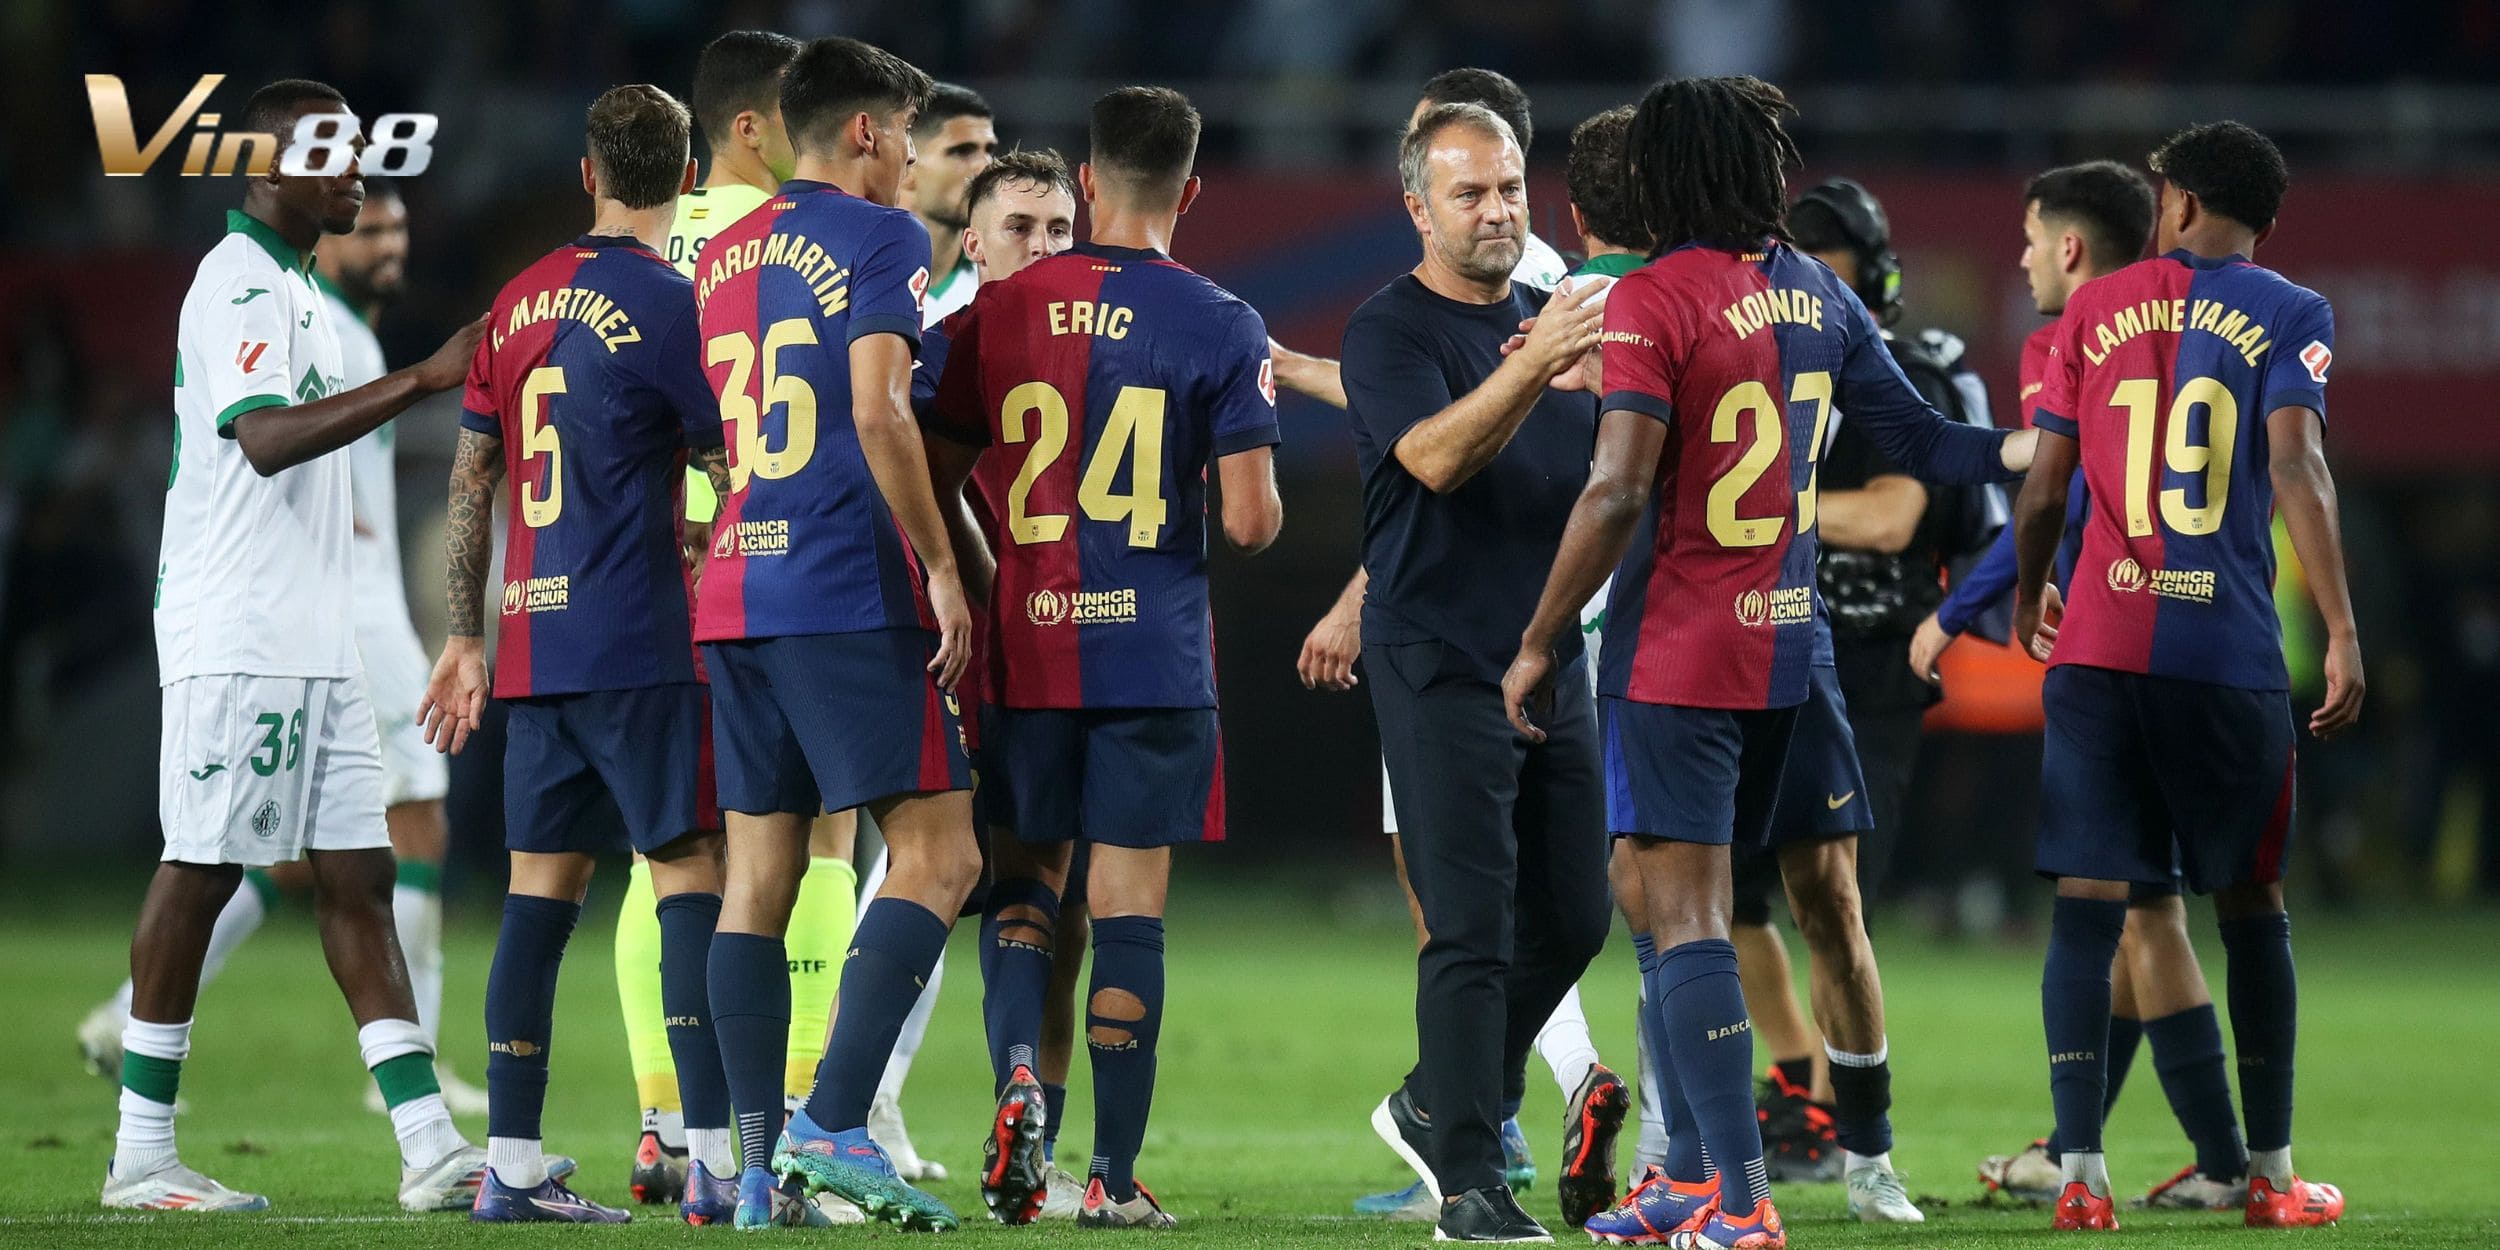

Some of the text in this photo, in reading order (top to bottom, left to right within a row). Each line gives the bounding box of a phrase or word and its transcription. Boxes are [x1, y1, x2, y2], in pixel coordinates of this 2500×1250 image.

[761, 233, 850, 318] MARTÍN
[509, 288, 642, 353] MARTINEZ
[1048, 301, 1133, 340] ERIC
[2083, 300, 2185, 367] LAMINE
[2189, 300, 2272, 367] YAMAL
[707, 317, 819, 495] 35
[522, 367, 567, 528] 5
[1001, 381, 1167, 548] 24
[2108, 377, 2238, 538] 19
[736, 520, 789, 536] UNHCR
[739, 534, 788, 551] ACNUR
[526, 575, 569, 593] UNHCR
[2151, 569, 2216, 585] UNHCR
[526, 589, 568, 607] ACNUR
[1071, 588, 1136, 606] UNHCR
[1769, 587, 1810, 605] UNHCR
[2148, 580, 2214, 598] ACNUR
[1070, 602, 1136, 619] ACNUR
[1769, 601, 1811, 619] ACNUR
[250, 708, 302, 777] 36
